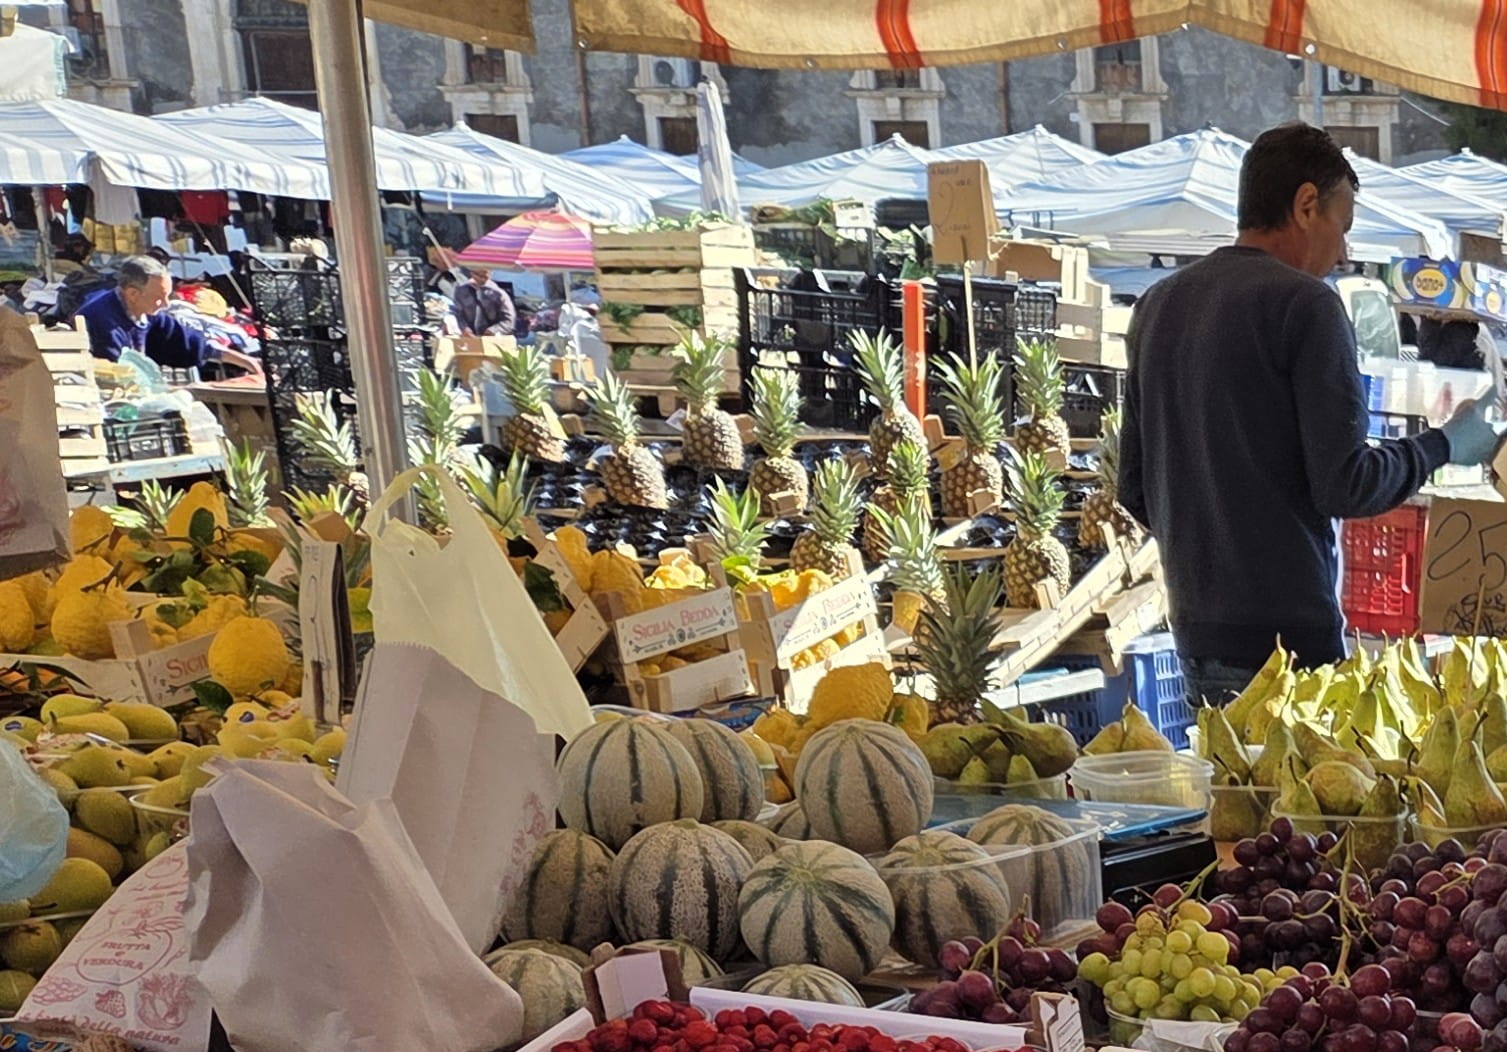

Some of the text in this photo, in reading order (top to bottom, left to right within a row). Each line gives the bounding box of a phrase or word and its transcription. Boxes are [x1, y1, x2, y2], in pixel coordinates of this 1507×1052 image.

[632, 605, 720, 641] SICILIA BEDDA
[101, 940, 150, 950] FRUTTA
[83, 958, 145, 971] VERDURA
